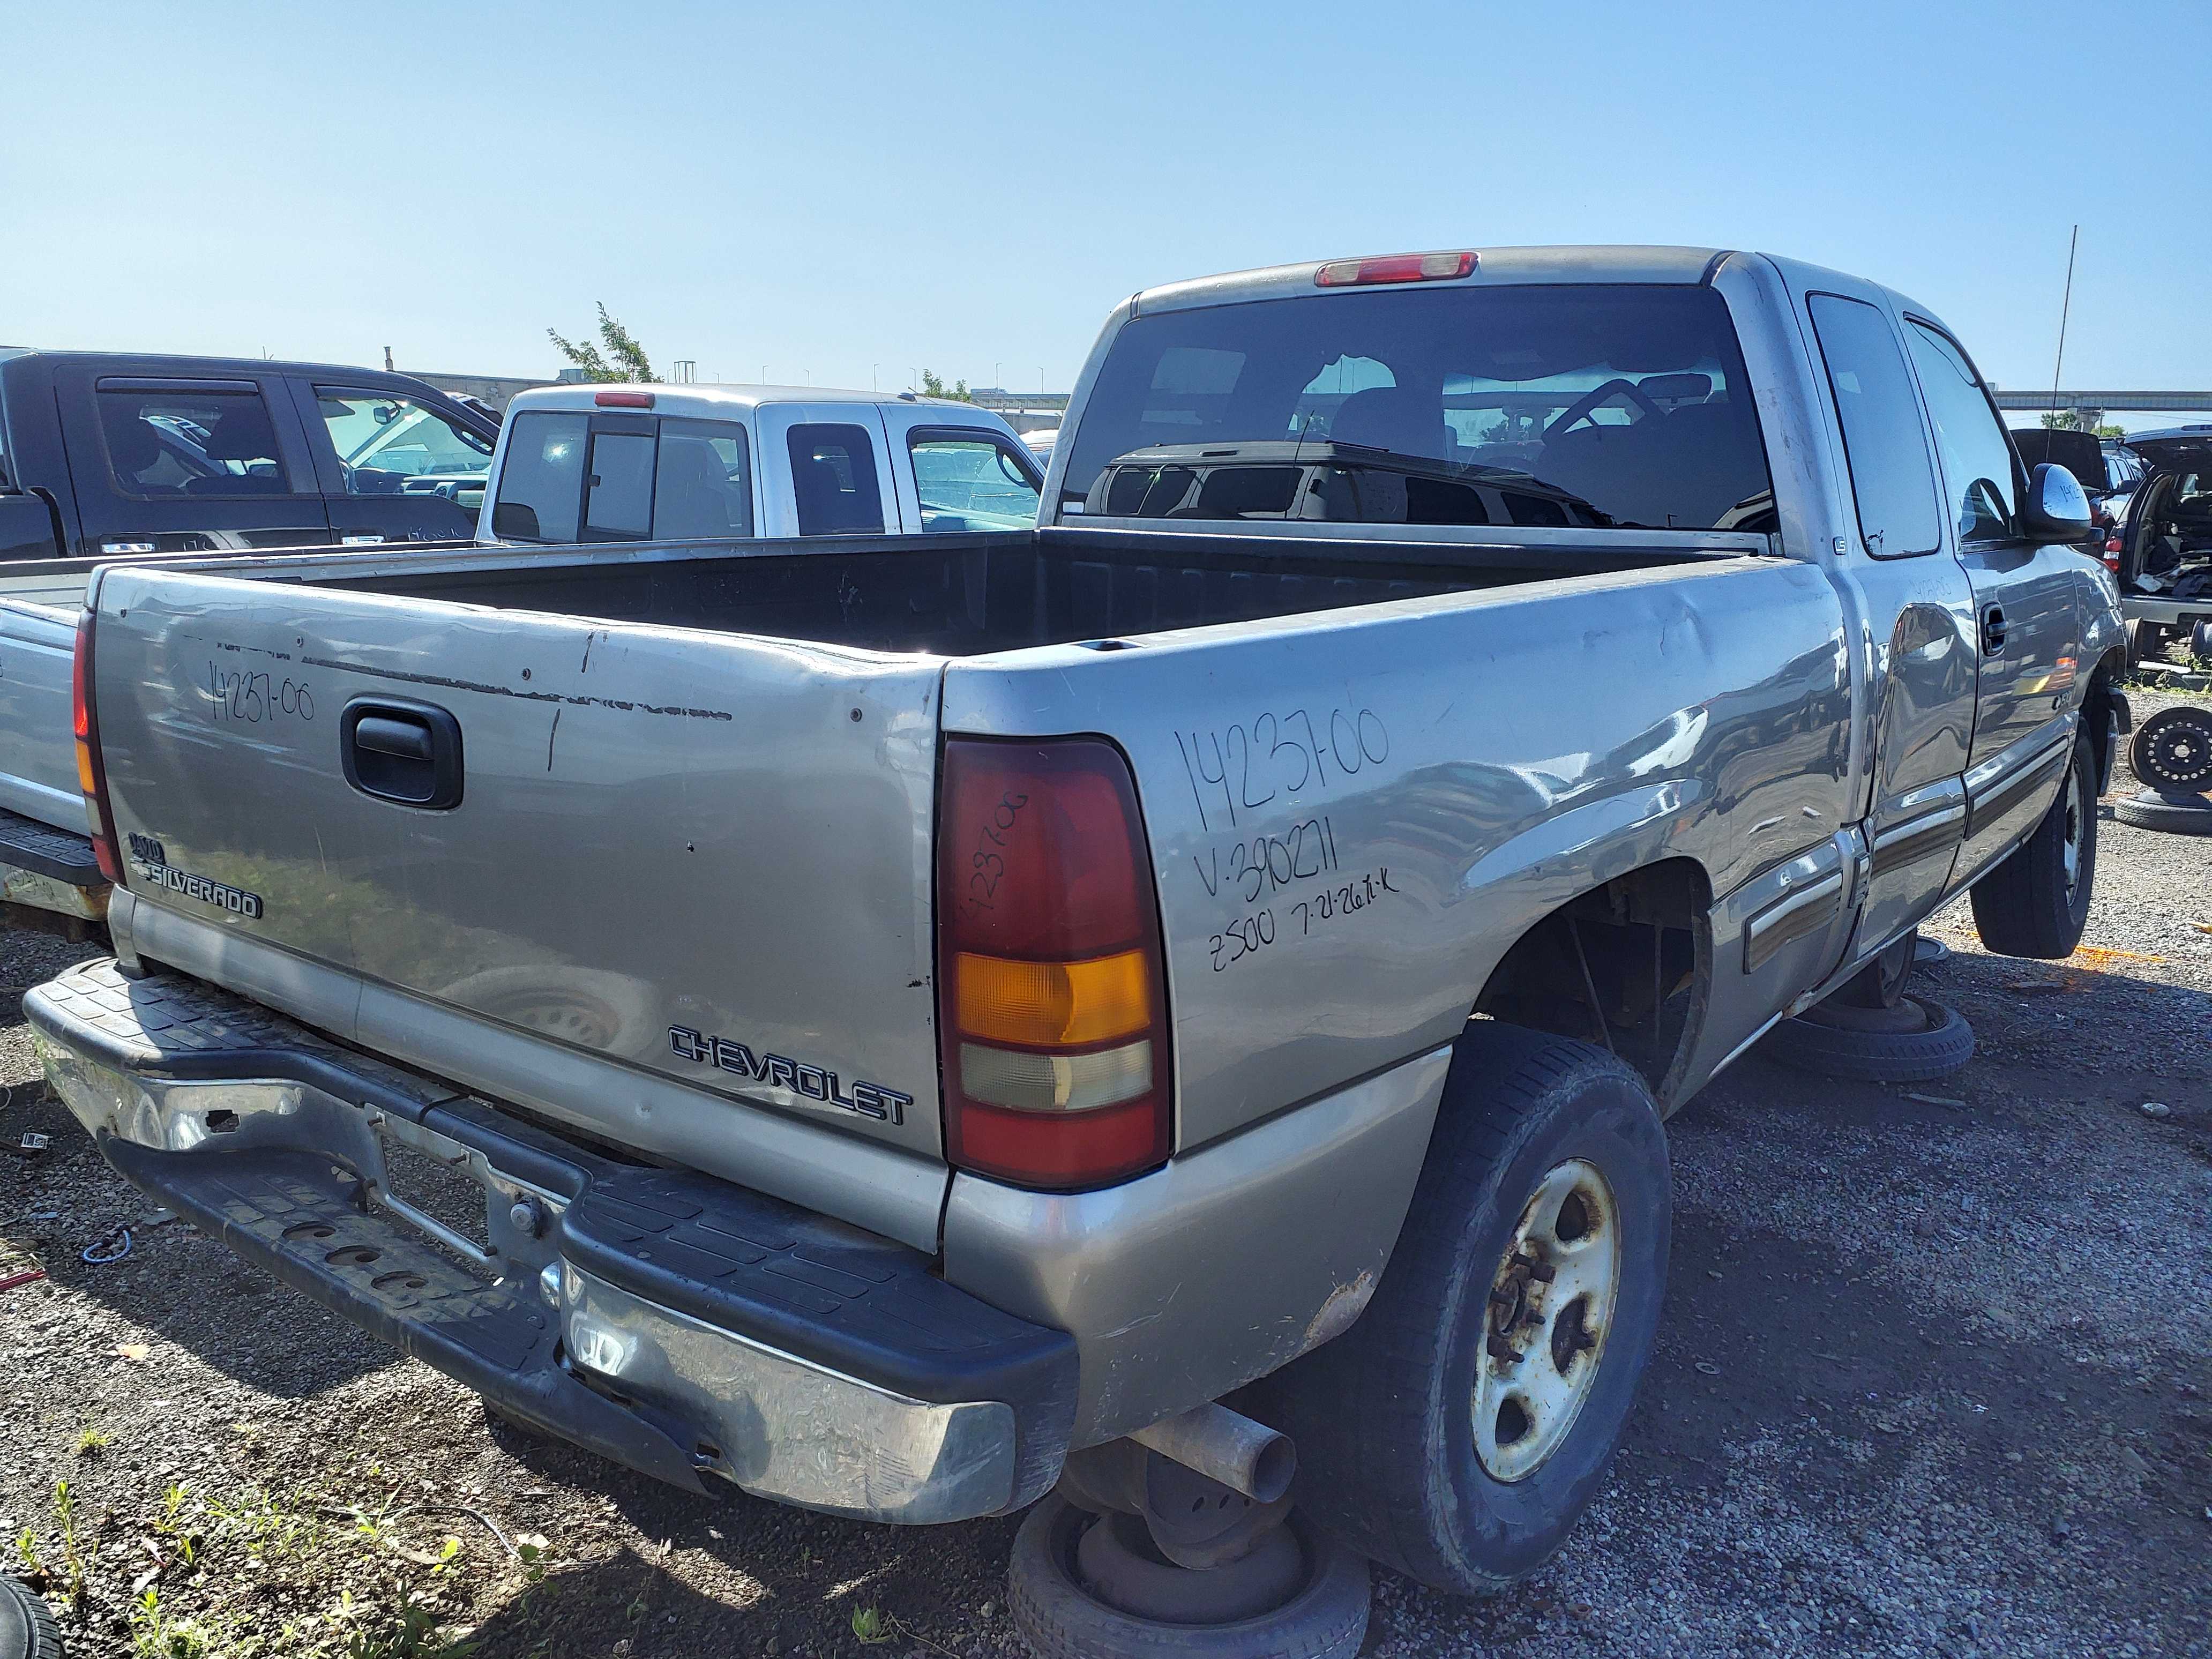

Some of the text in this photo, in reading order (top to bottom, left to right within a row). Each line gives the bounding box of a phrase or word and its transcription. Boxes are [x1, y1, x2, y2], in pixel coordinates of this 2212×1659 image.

[1835, 540, 1846, 551] LS
[1174, 708, 1389, 832] 14237-00
[151, 862, 264, 920] SILVERADO
[668, 1024, 913, 1126] CHEVROLET
